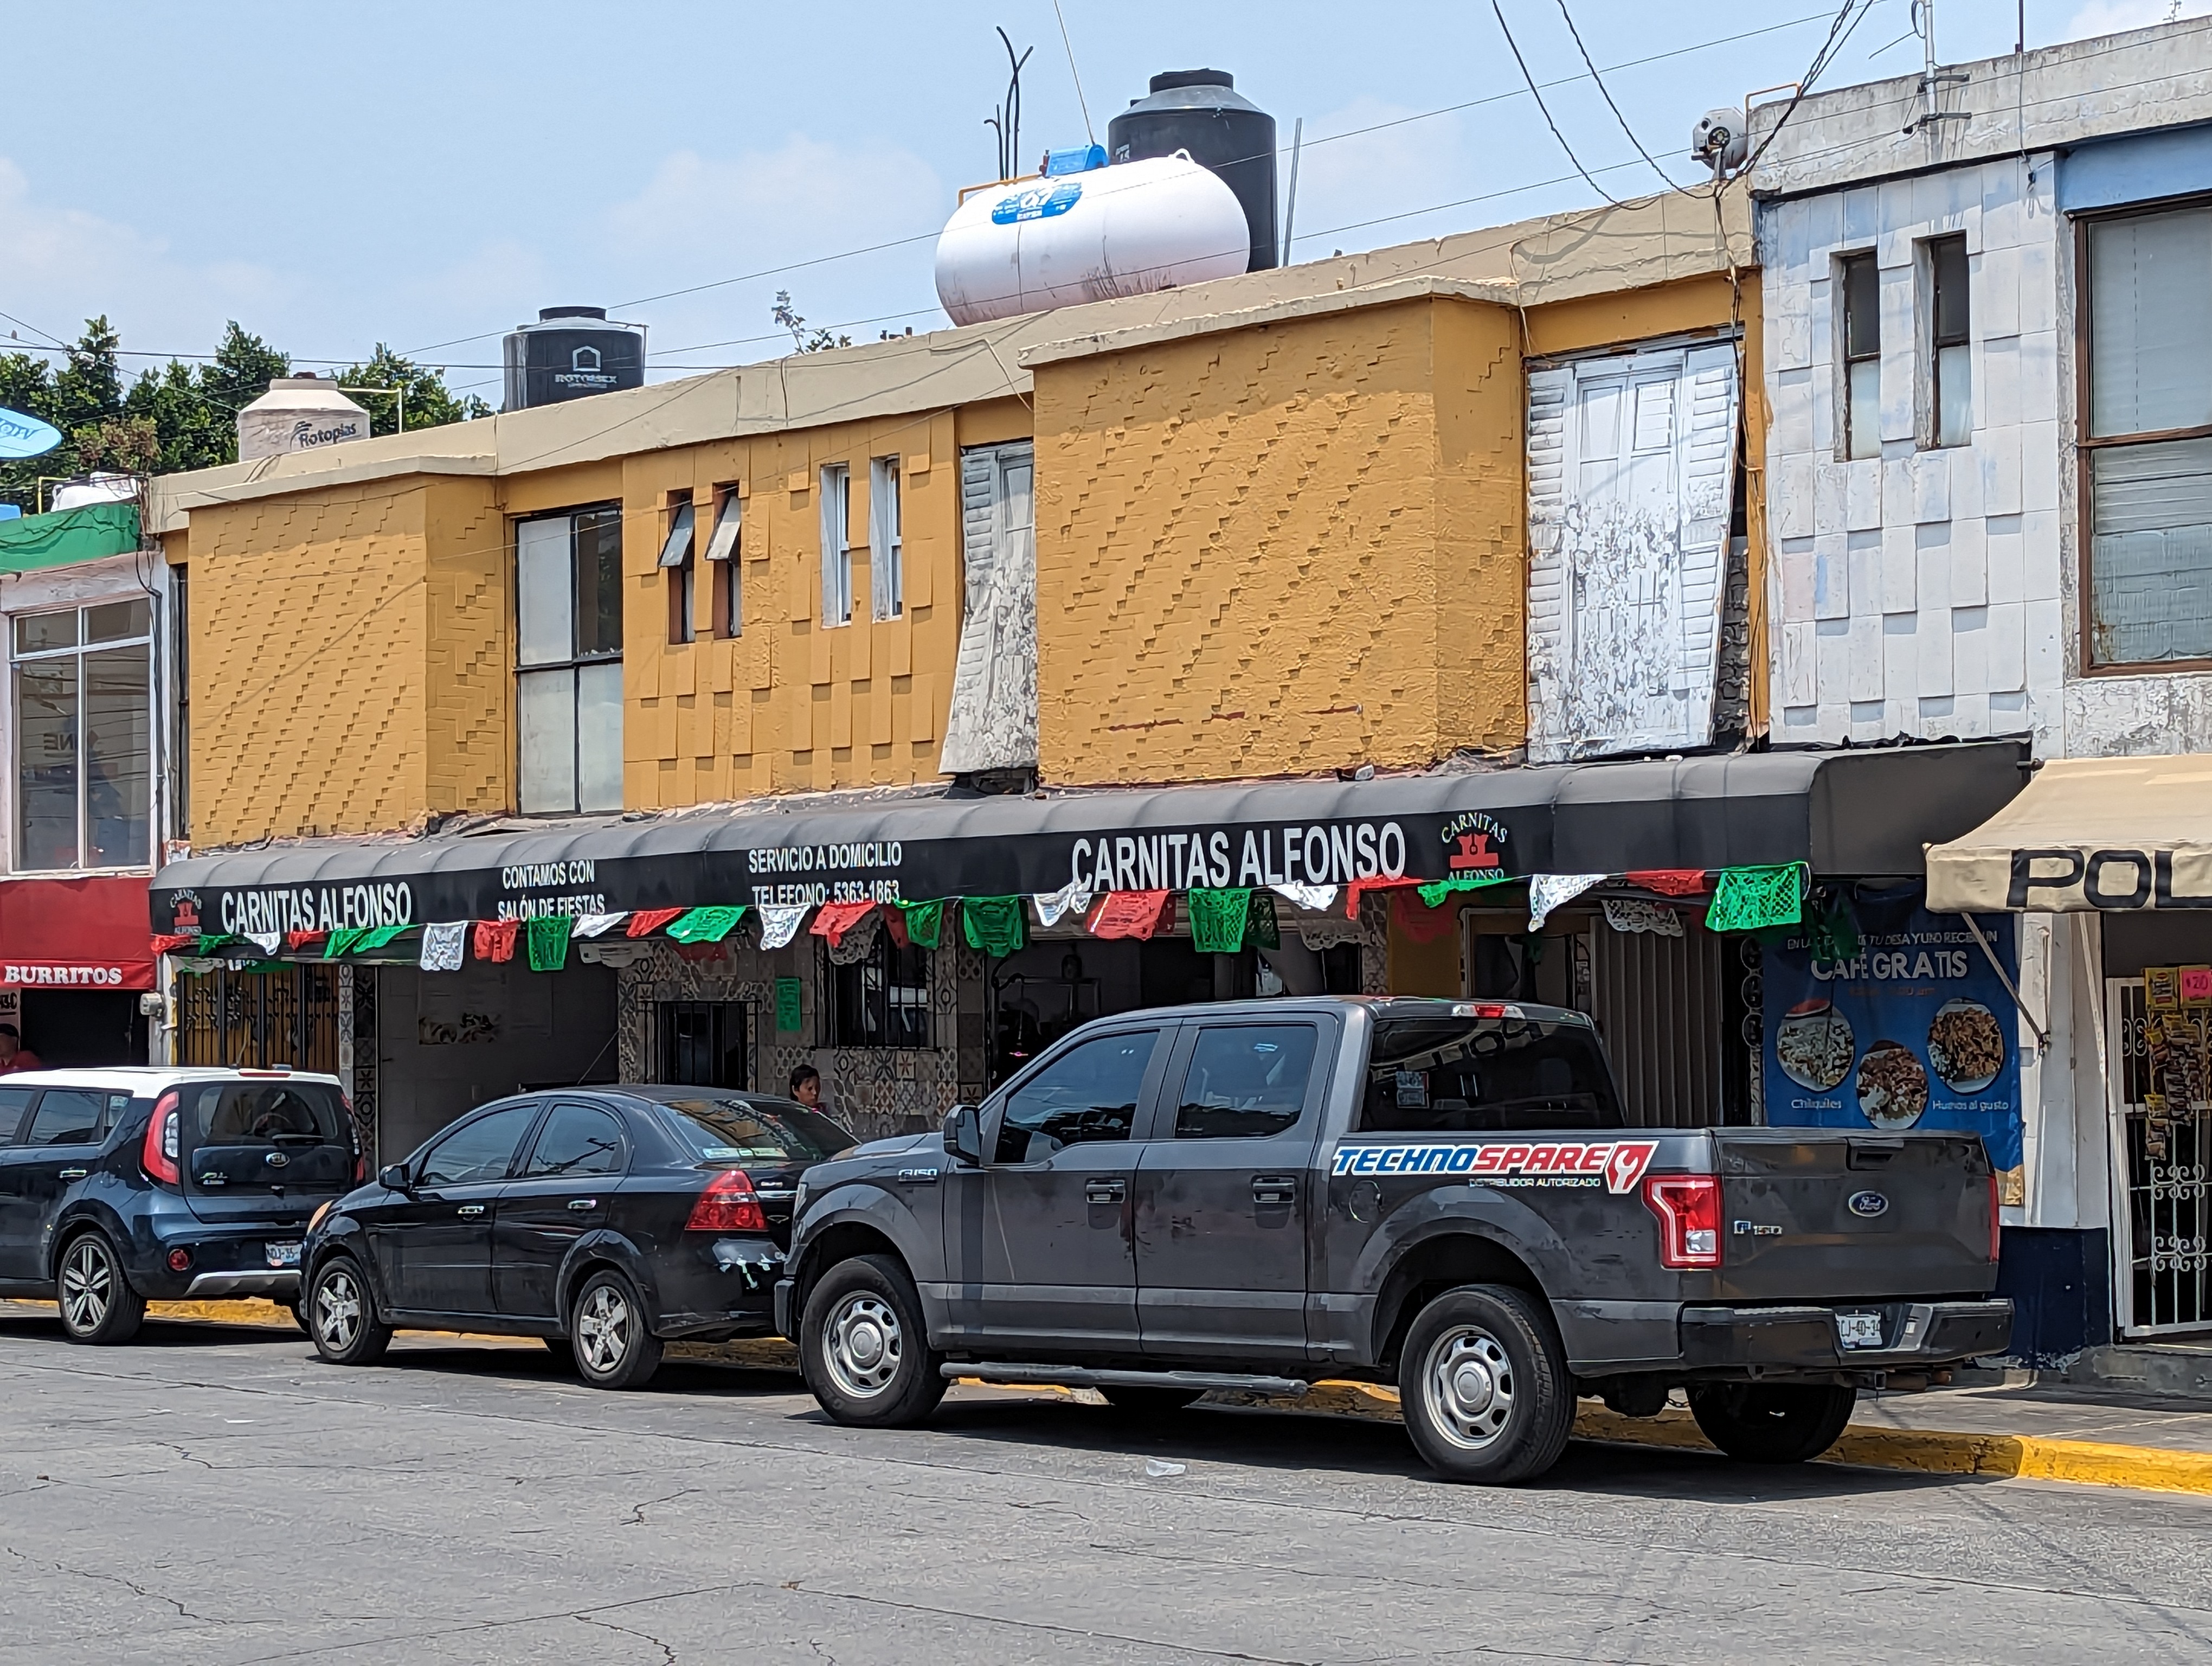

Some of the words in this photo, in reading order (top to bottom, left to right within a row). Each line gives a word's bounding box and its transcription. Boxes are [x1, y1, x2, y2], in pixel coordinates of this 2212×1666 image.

[1441, 812, 1507, 843] CARNITAS
[749, 845, 813, 874] SERVICIO
[816, 845, 827, 870] A
[829, 841, 902, 869] DOMICILIO
[1072, 831, 1230, 892] CARNITAS
[1239, 822, 1405, 886] ALFONSO
[503, 861, 566, 889] CONTAMOS
[569, 858, 595, 884] CON
[1448, 868, 1504, 881] ALFONSO
[2006, 849, 2212, 909] POL
[221, 888, 314, 934] CARNITAS
[319, 881, 411, 931] ALFONSO
[539, 898, 555, 919] DE
[557, 894, 605, 918] FIESTAS
[4, 965, 123, 984] BURRITOS
[1872, 951, 1967, 979] GRATIS
[1332, 1143, 1610, 1176] TECHNOSPARE
[1535, 1178, 1601, 1187] AUTORIZADO
